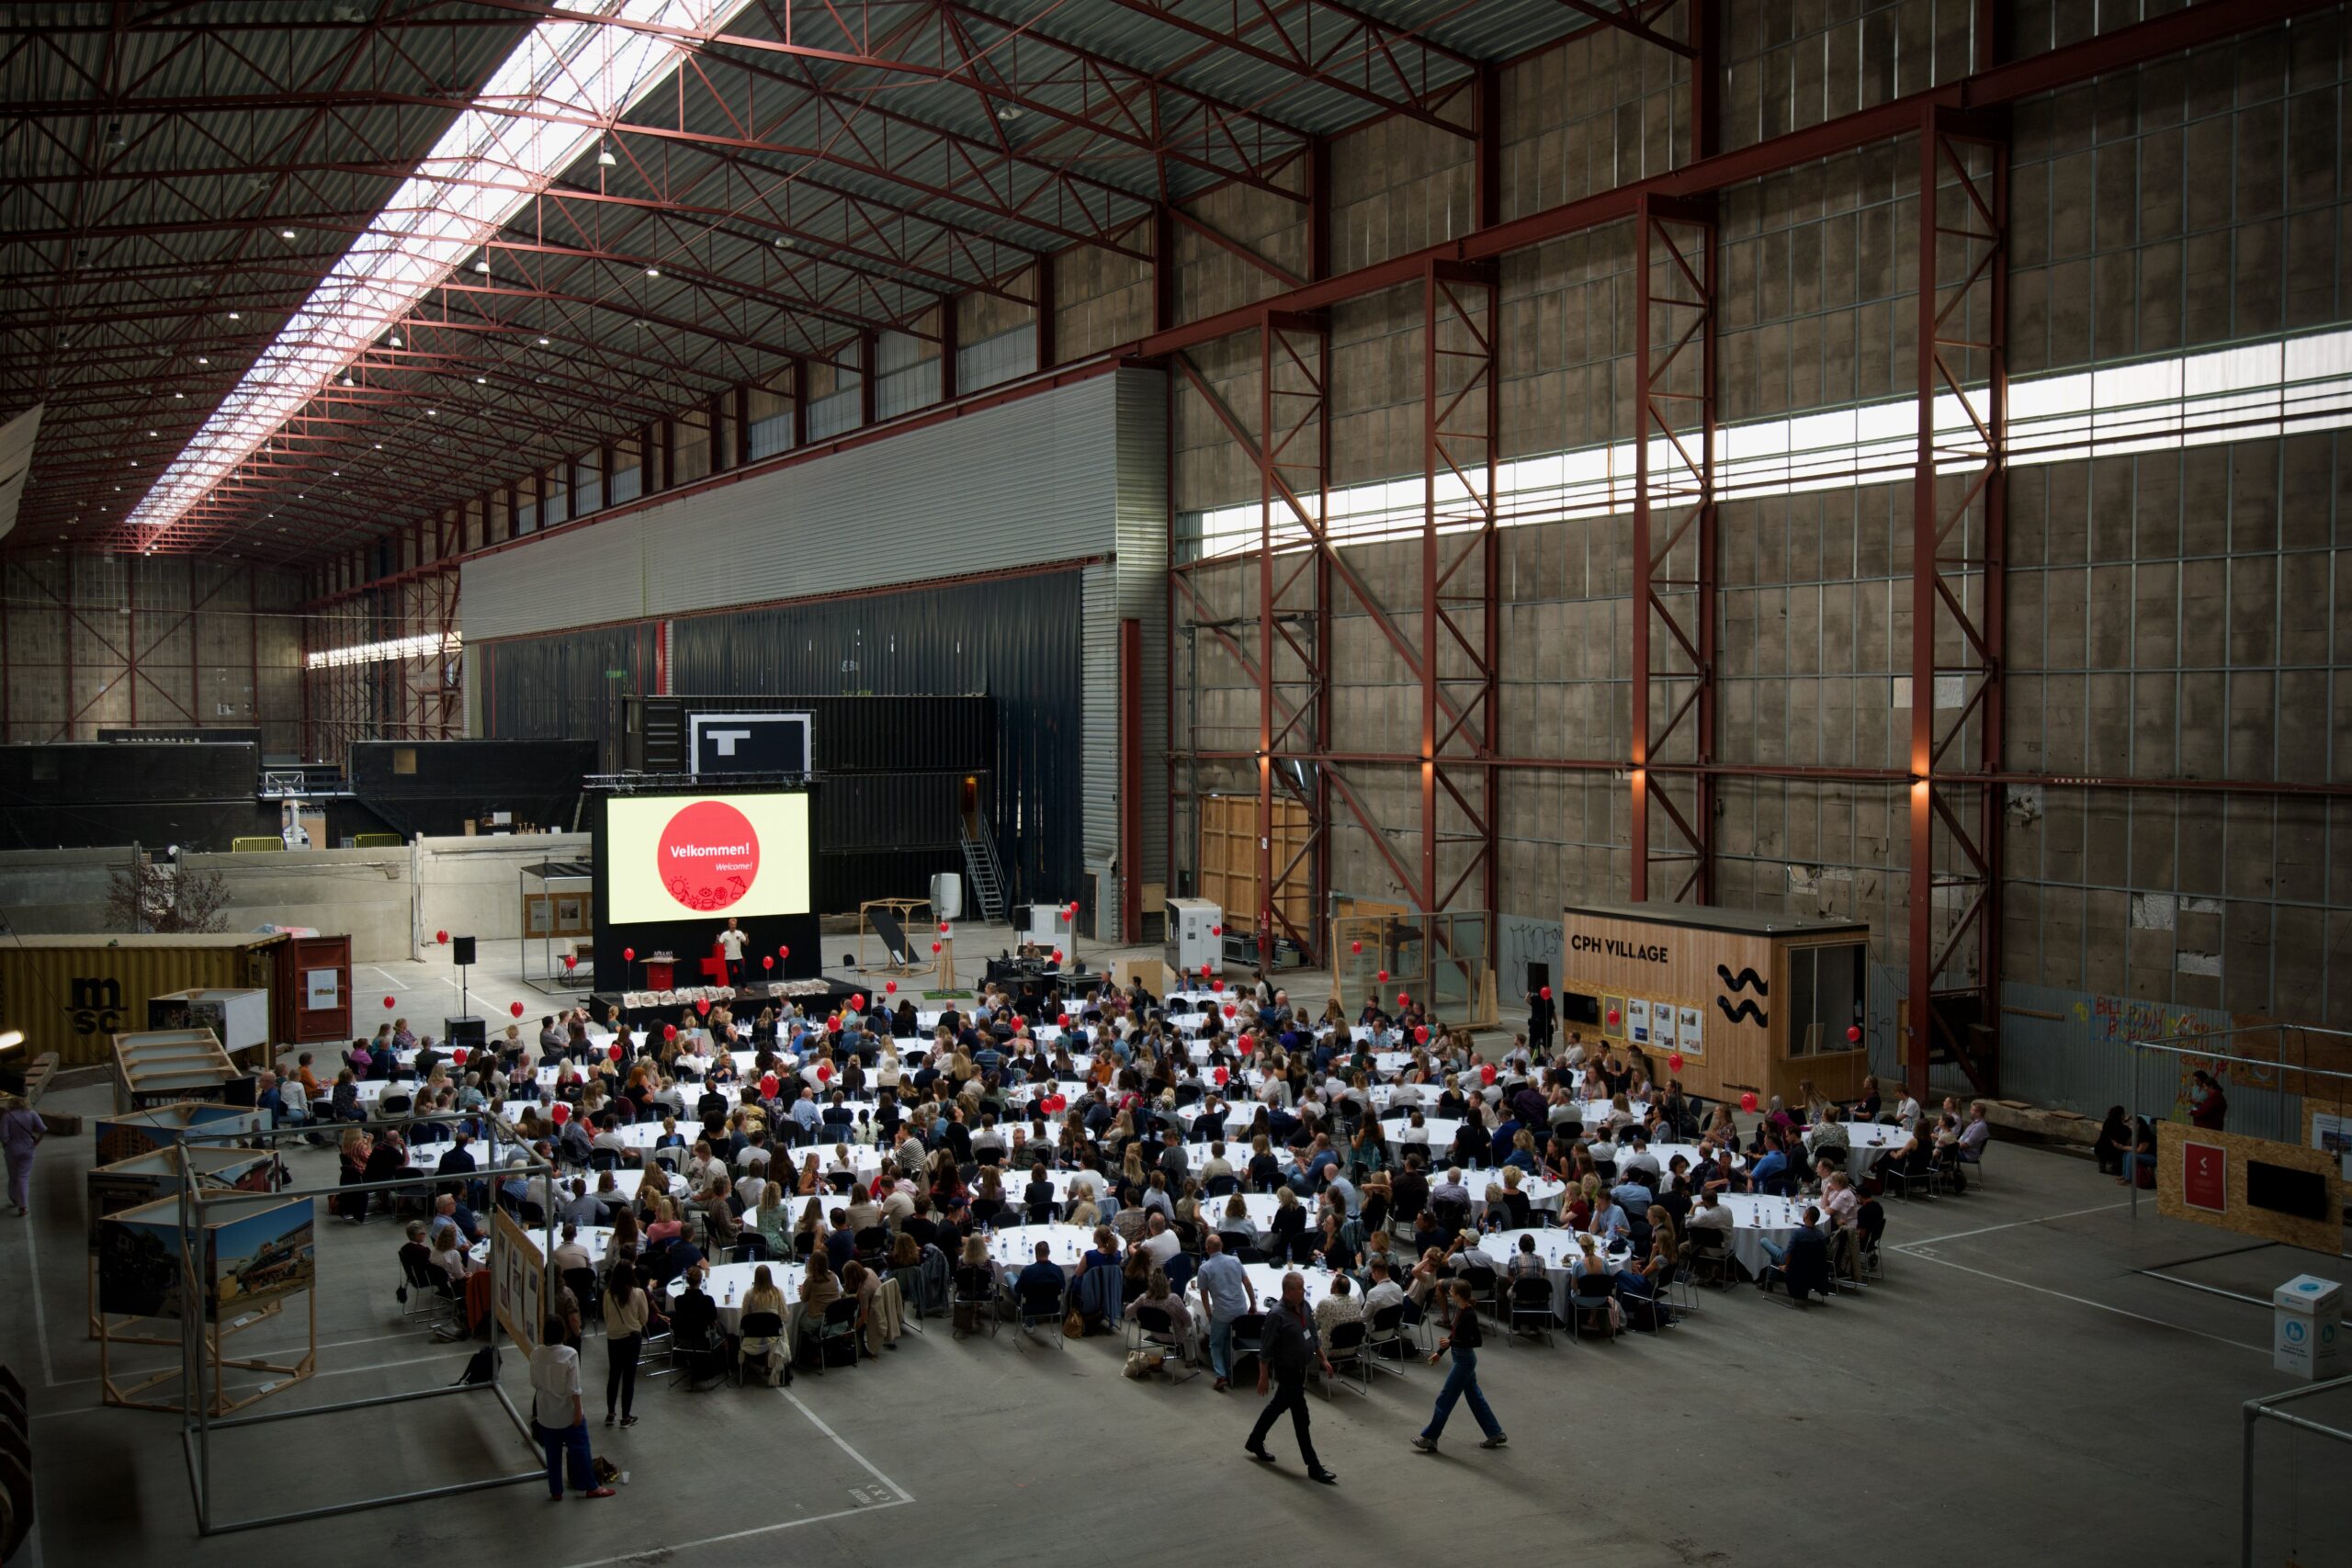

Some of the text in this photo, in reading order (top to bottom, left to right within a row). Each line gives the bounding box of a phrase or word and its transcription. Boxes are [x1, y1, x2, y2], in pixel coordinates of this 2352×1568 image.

[671, 842, 750, 858] Velkommen!
[716, 862, 752, 872] Welcome!
[1572, 935, 1668, 964] CPH VILLAGE
